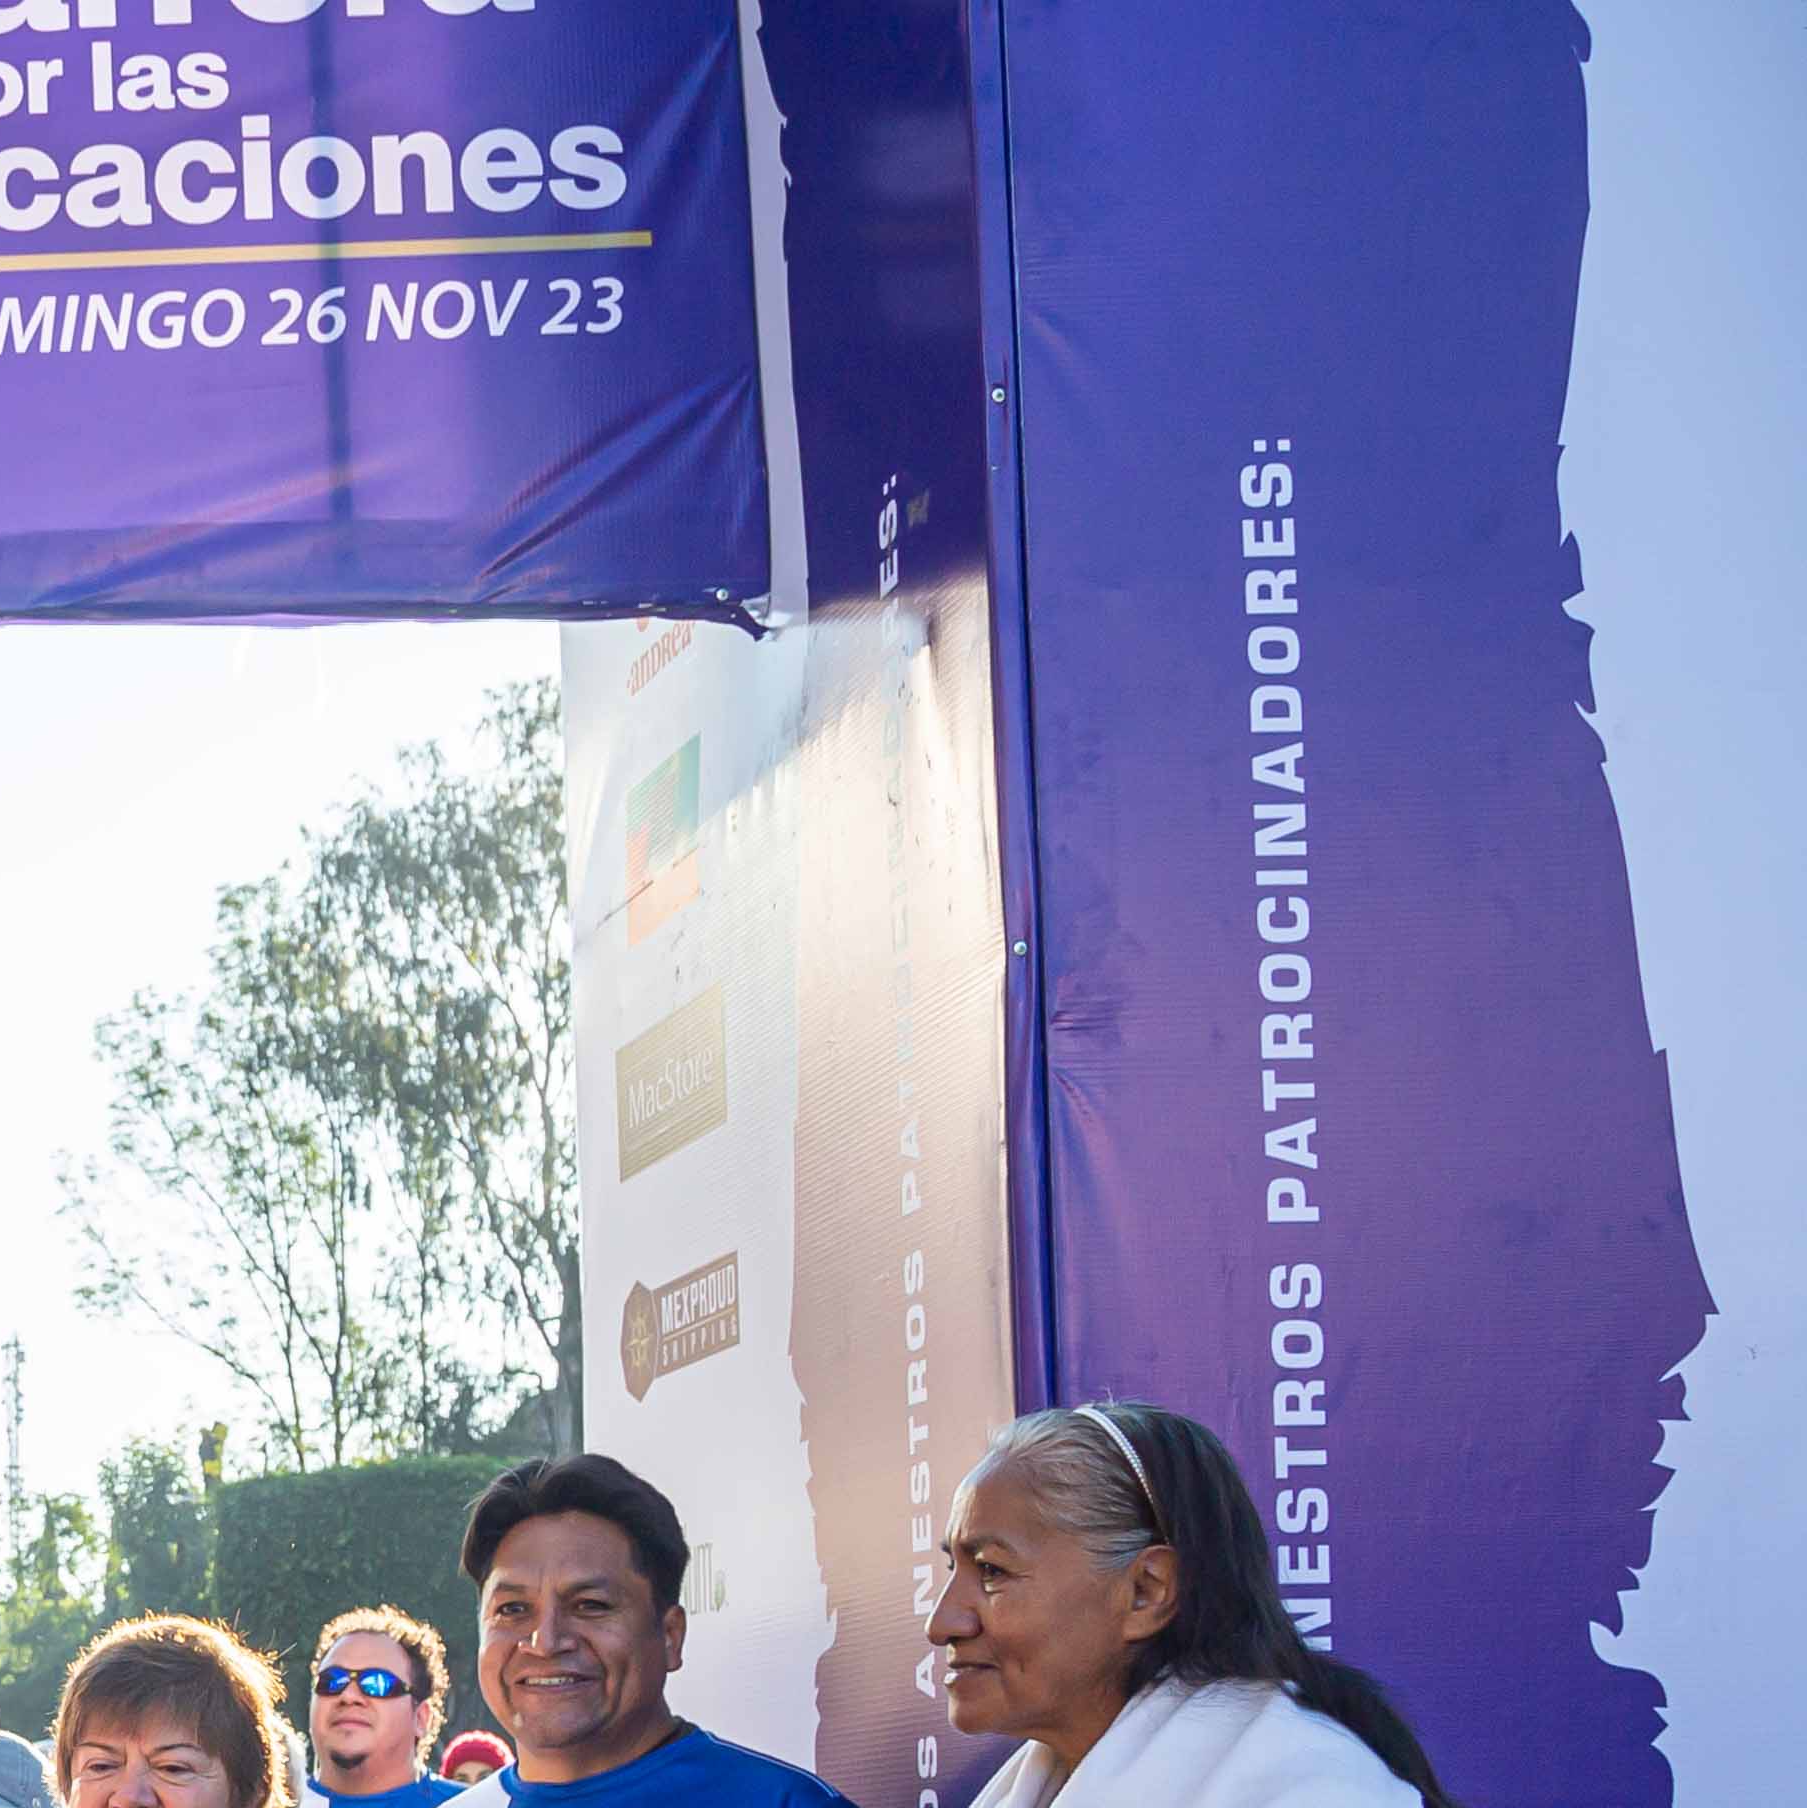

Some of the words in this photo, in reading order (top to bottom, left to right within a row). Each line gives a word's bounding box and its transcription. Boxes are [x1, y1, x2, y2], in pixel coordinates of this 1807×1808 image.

[91, 41, 230, 113] las
[261, 285, 347, 347] 26
[366, 279, 530, 342] NOV
[541, 277, 626, 337] 23
[1239, 437, 1320, 1226] PATROCINADORES:
[628, 1046, 713, 1129] MacStore
[661, 1263, 736, 1335] MEXPROUD
[904, 1249, 938, 1617] NESTROS
[1269, 1264, 1333, 1652] NESTROS
